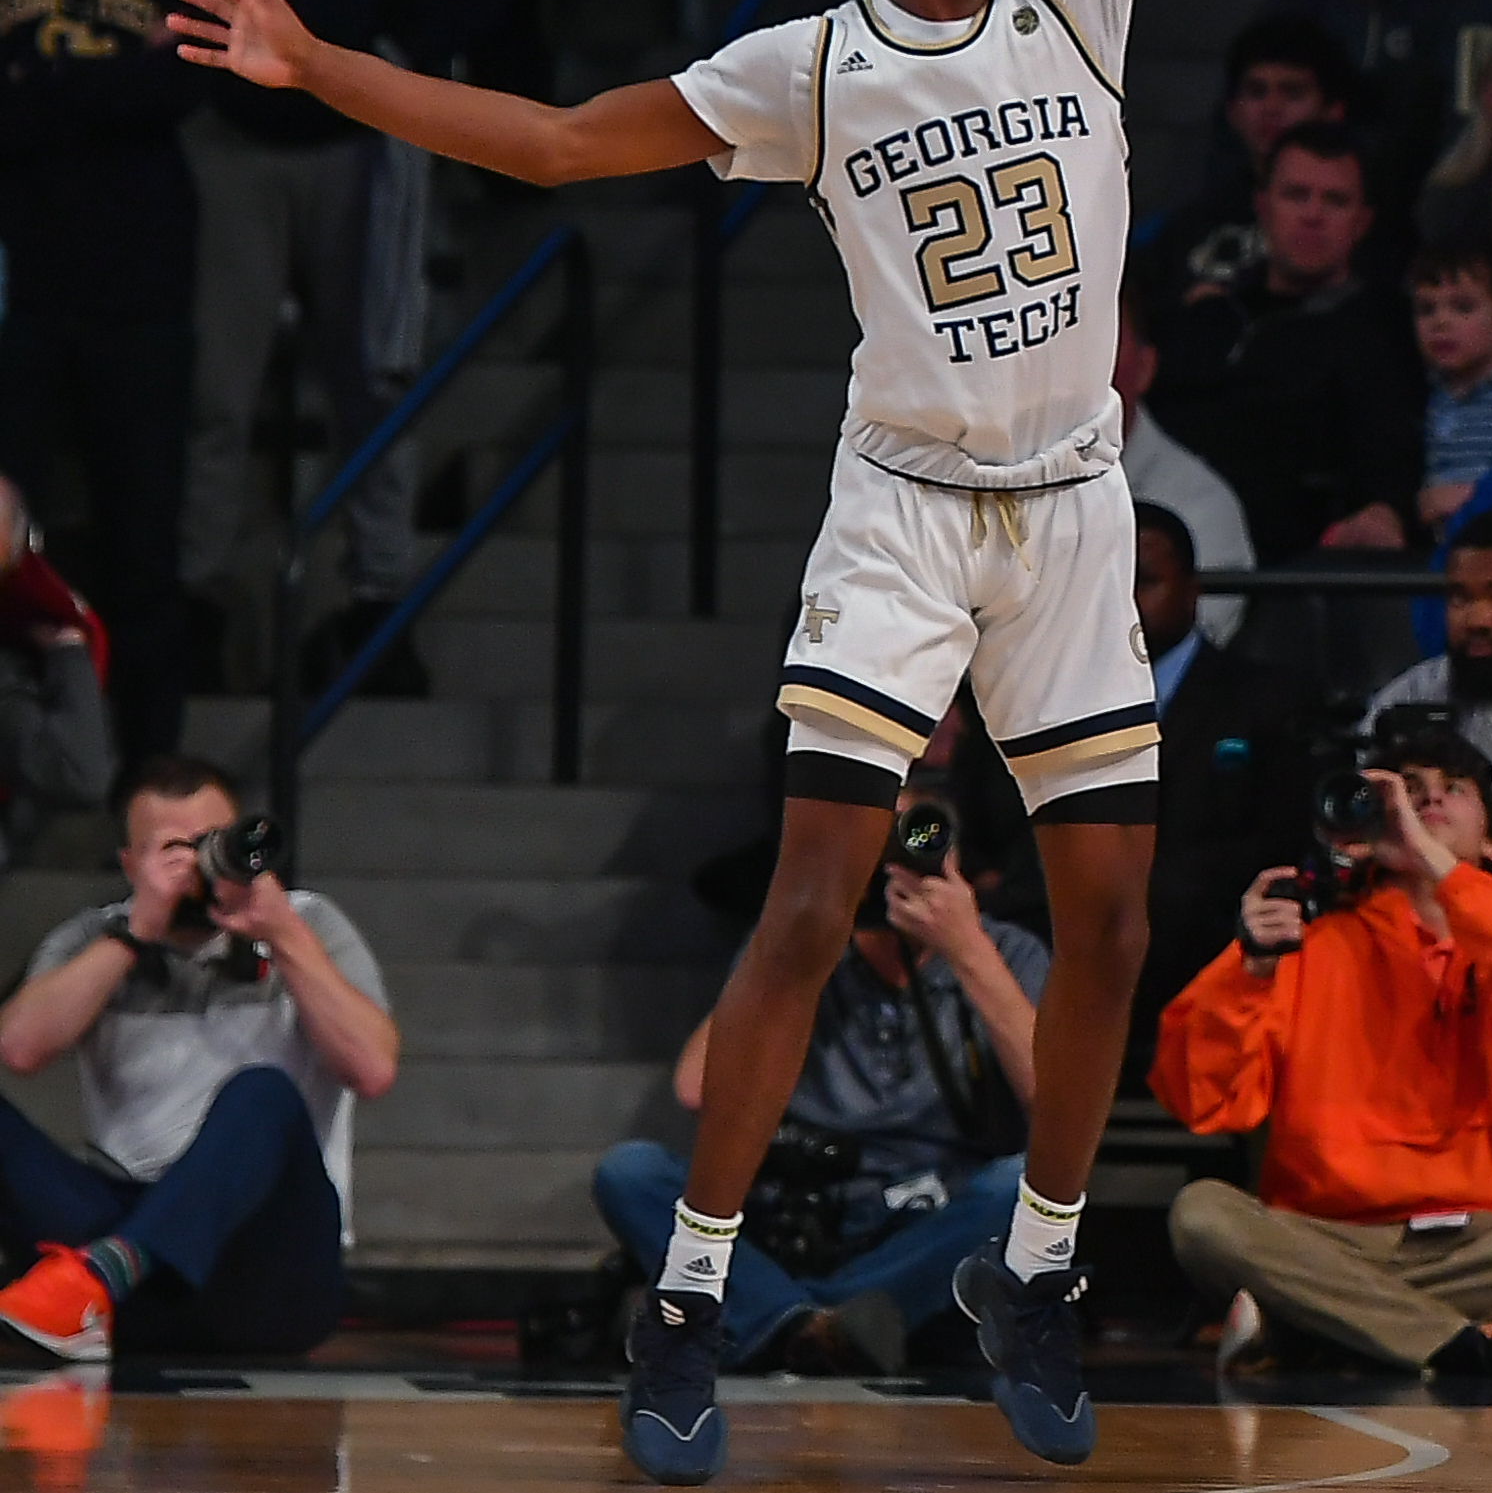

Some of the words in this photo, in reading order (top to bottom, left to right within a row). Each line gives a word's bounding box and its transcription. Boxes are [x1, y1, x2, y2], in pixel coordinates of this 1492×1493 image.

[845, 94, 1090, 198] GEORGIA
[898, 151, 1081, 314] 23
[934, 283, 1081, 363] TECH
